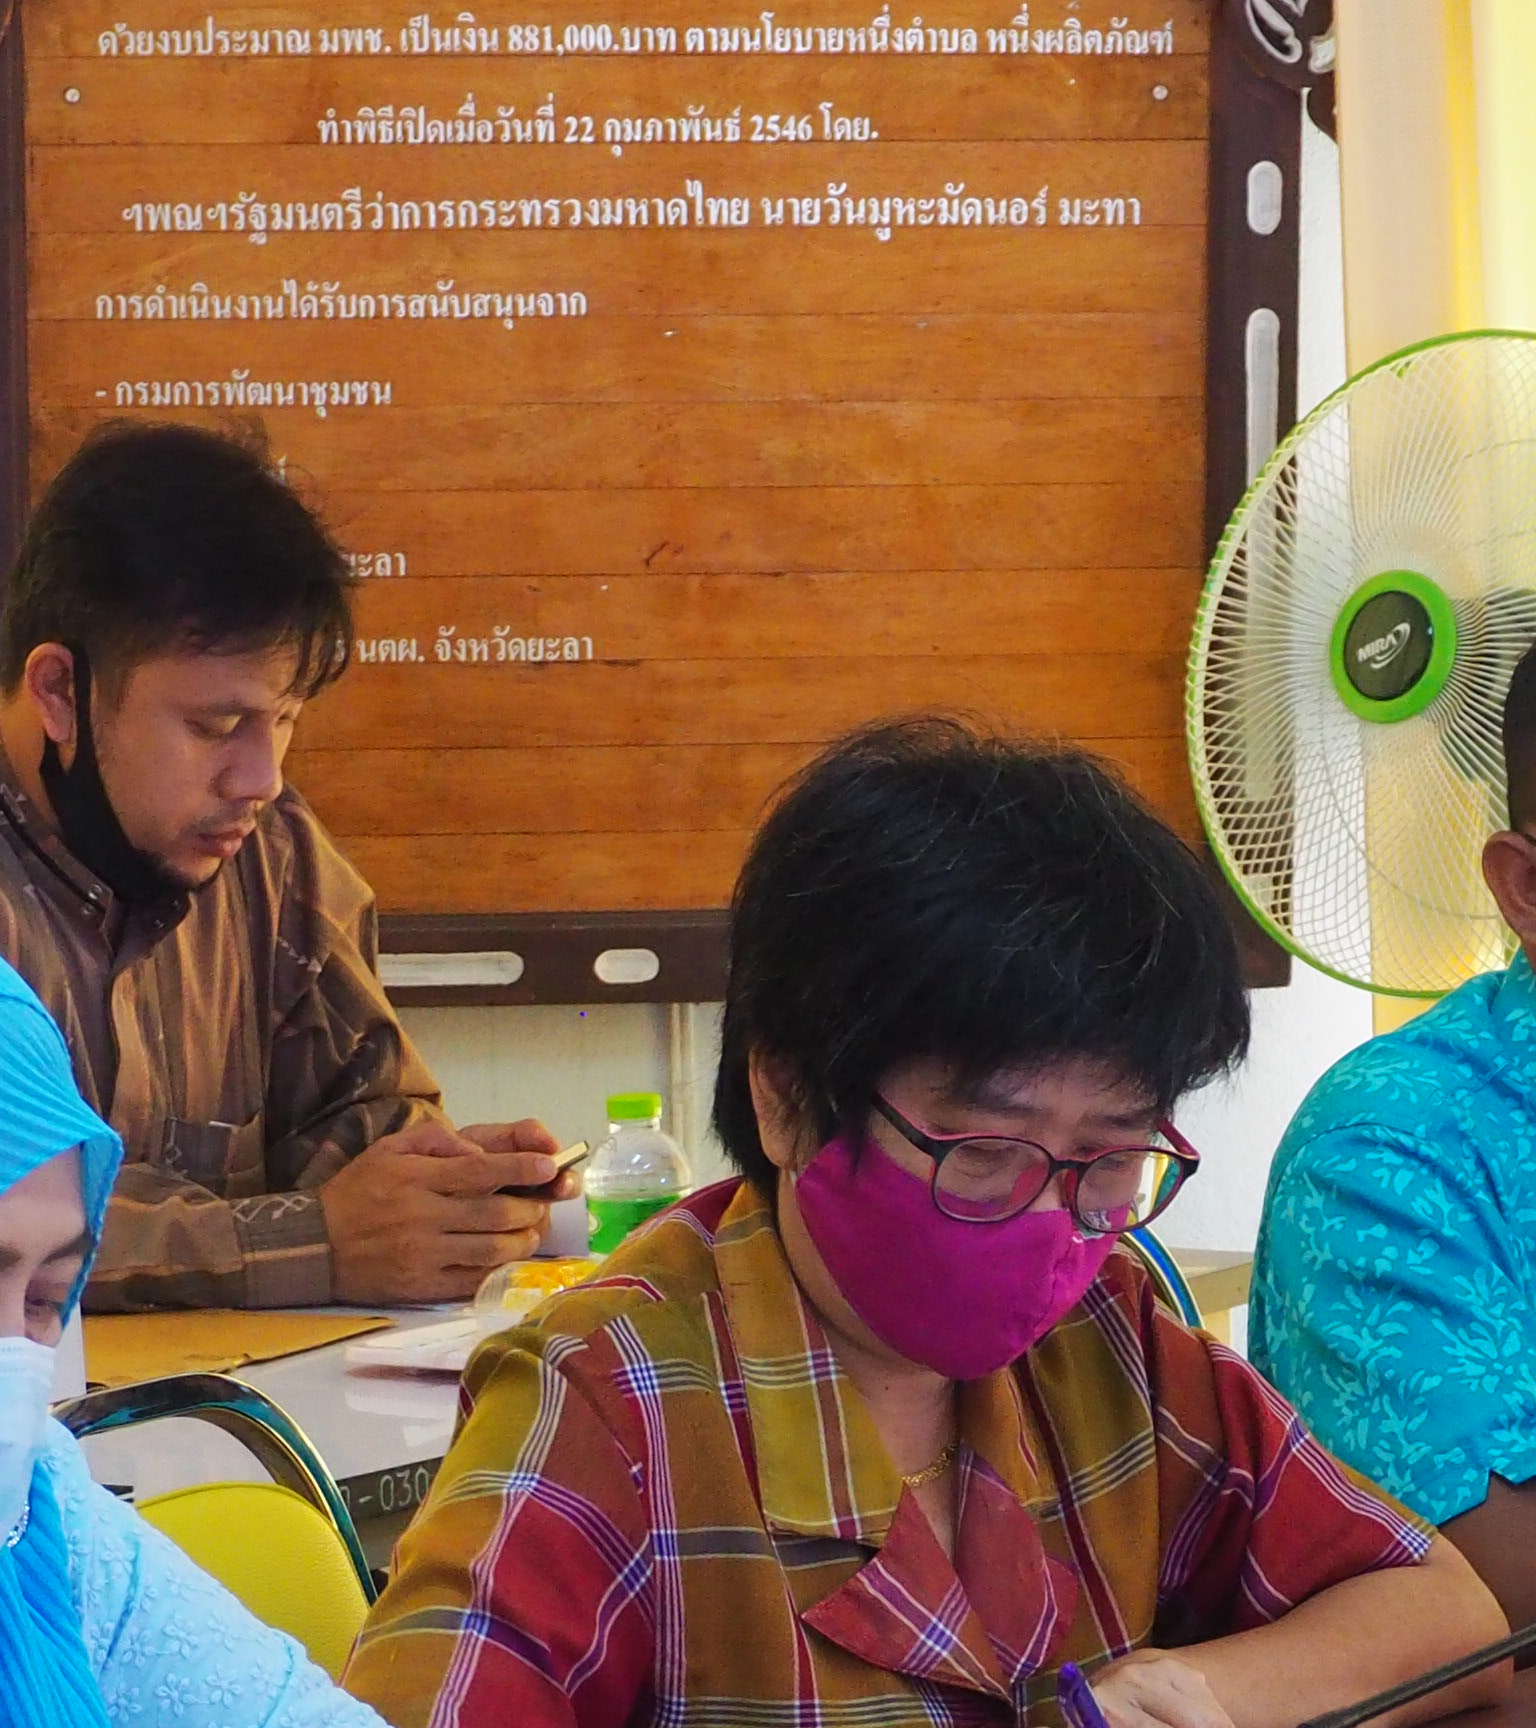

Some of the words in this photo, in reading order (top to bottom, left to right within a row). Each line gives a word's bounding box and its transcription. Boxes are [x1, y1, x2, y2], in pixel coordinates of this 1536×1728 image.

[399, 12, 500, 55] เป็นเงิน
[684, 3, 979, 54] ตามนโยบายหนึ่งตำบล
[985, 3, 1174, 54] หนึ่งผลิตภัณฑ์
[317, 92, 556, 145] ทำพิธีเปิดเมื่อวันที่
[563, 116, 595, 144] 22
[603, 104, 742, 158] กุมภาพันธ์
[749, 113, 813, 143] 2546
[819, 102, 880, 142] โดย.
[759, 183, 1049, 242] นายวันมูหะมัดนอร์
[1057, 193, 1142, 226] มะทา
[95, 278, 588, 330] การดำเนินงานได้รับการสนับสนุนจาก
[114, 368, 393, 418] กรมการพัฒนาชุมชน
[434, 625, 594, 662] จังหวัดยะลา
